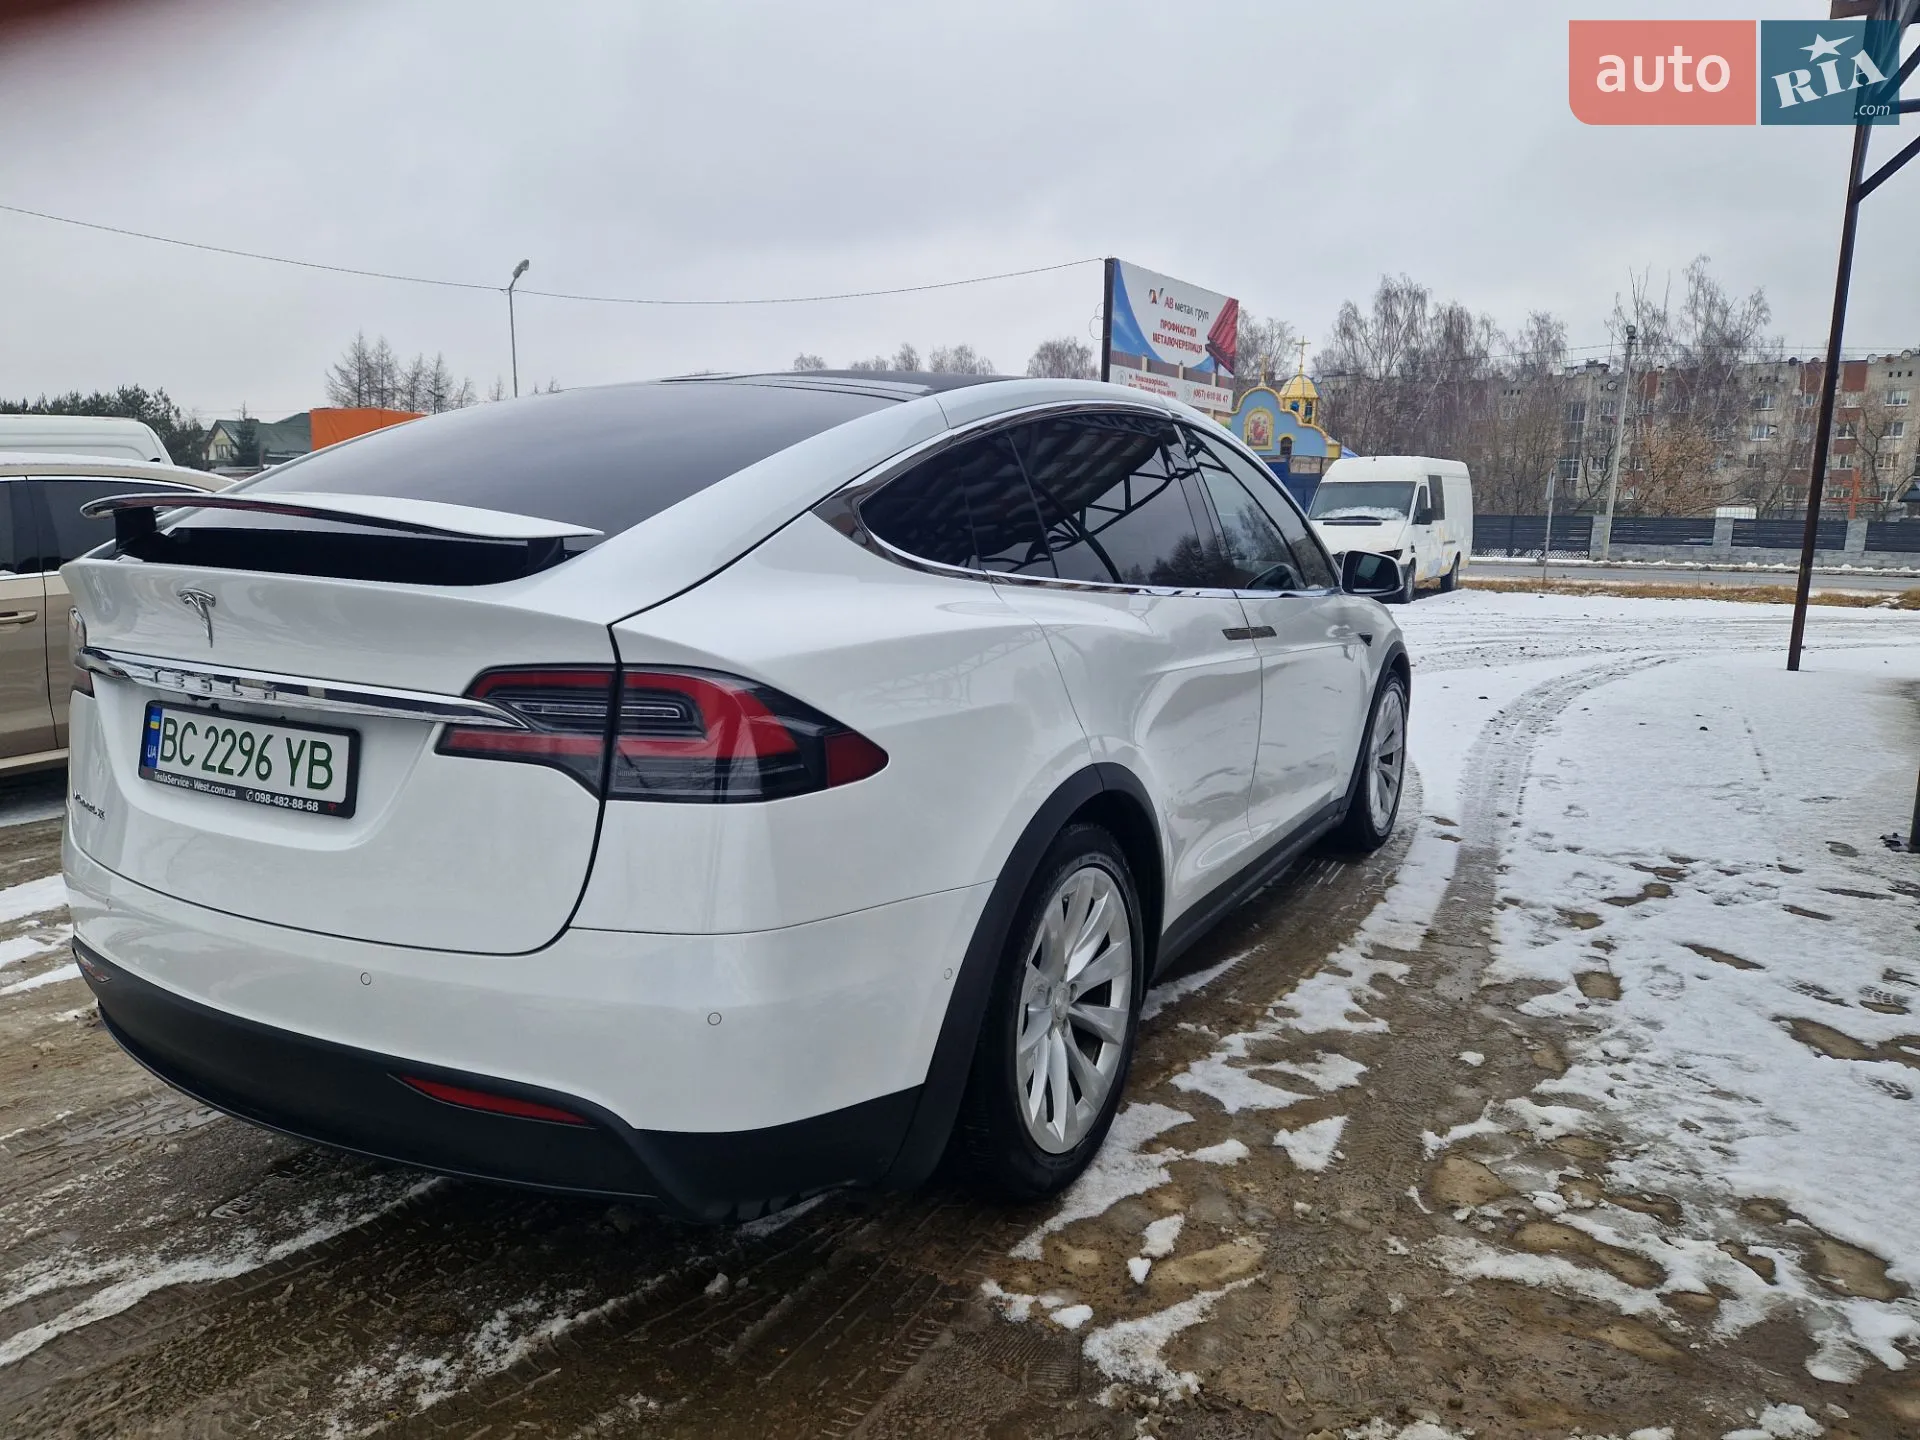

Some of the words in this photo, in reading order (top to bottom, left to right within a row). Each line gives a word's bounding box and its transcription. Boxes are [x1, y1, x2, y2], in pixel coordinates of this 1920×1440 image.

[147, 744, 157, 760] UA
[160, 717, 198, 766] BC
[201, 726, 274, 781] 2296
[286, 737, 333, 790] YB
[254, 792, 319, 812] 098-482-88-68
